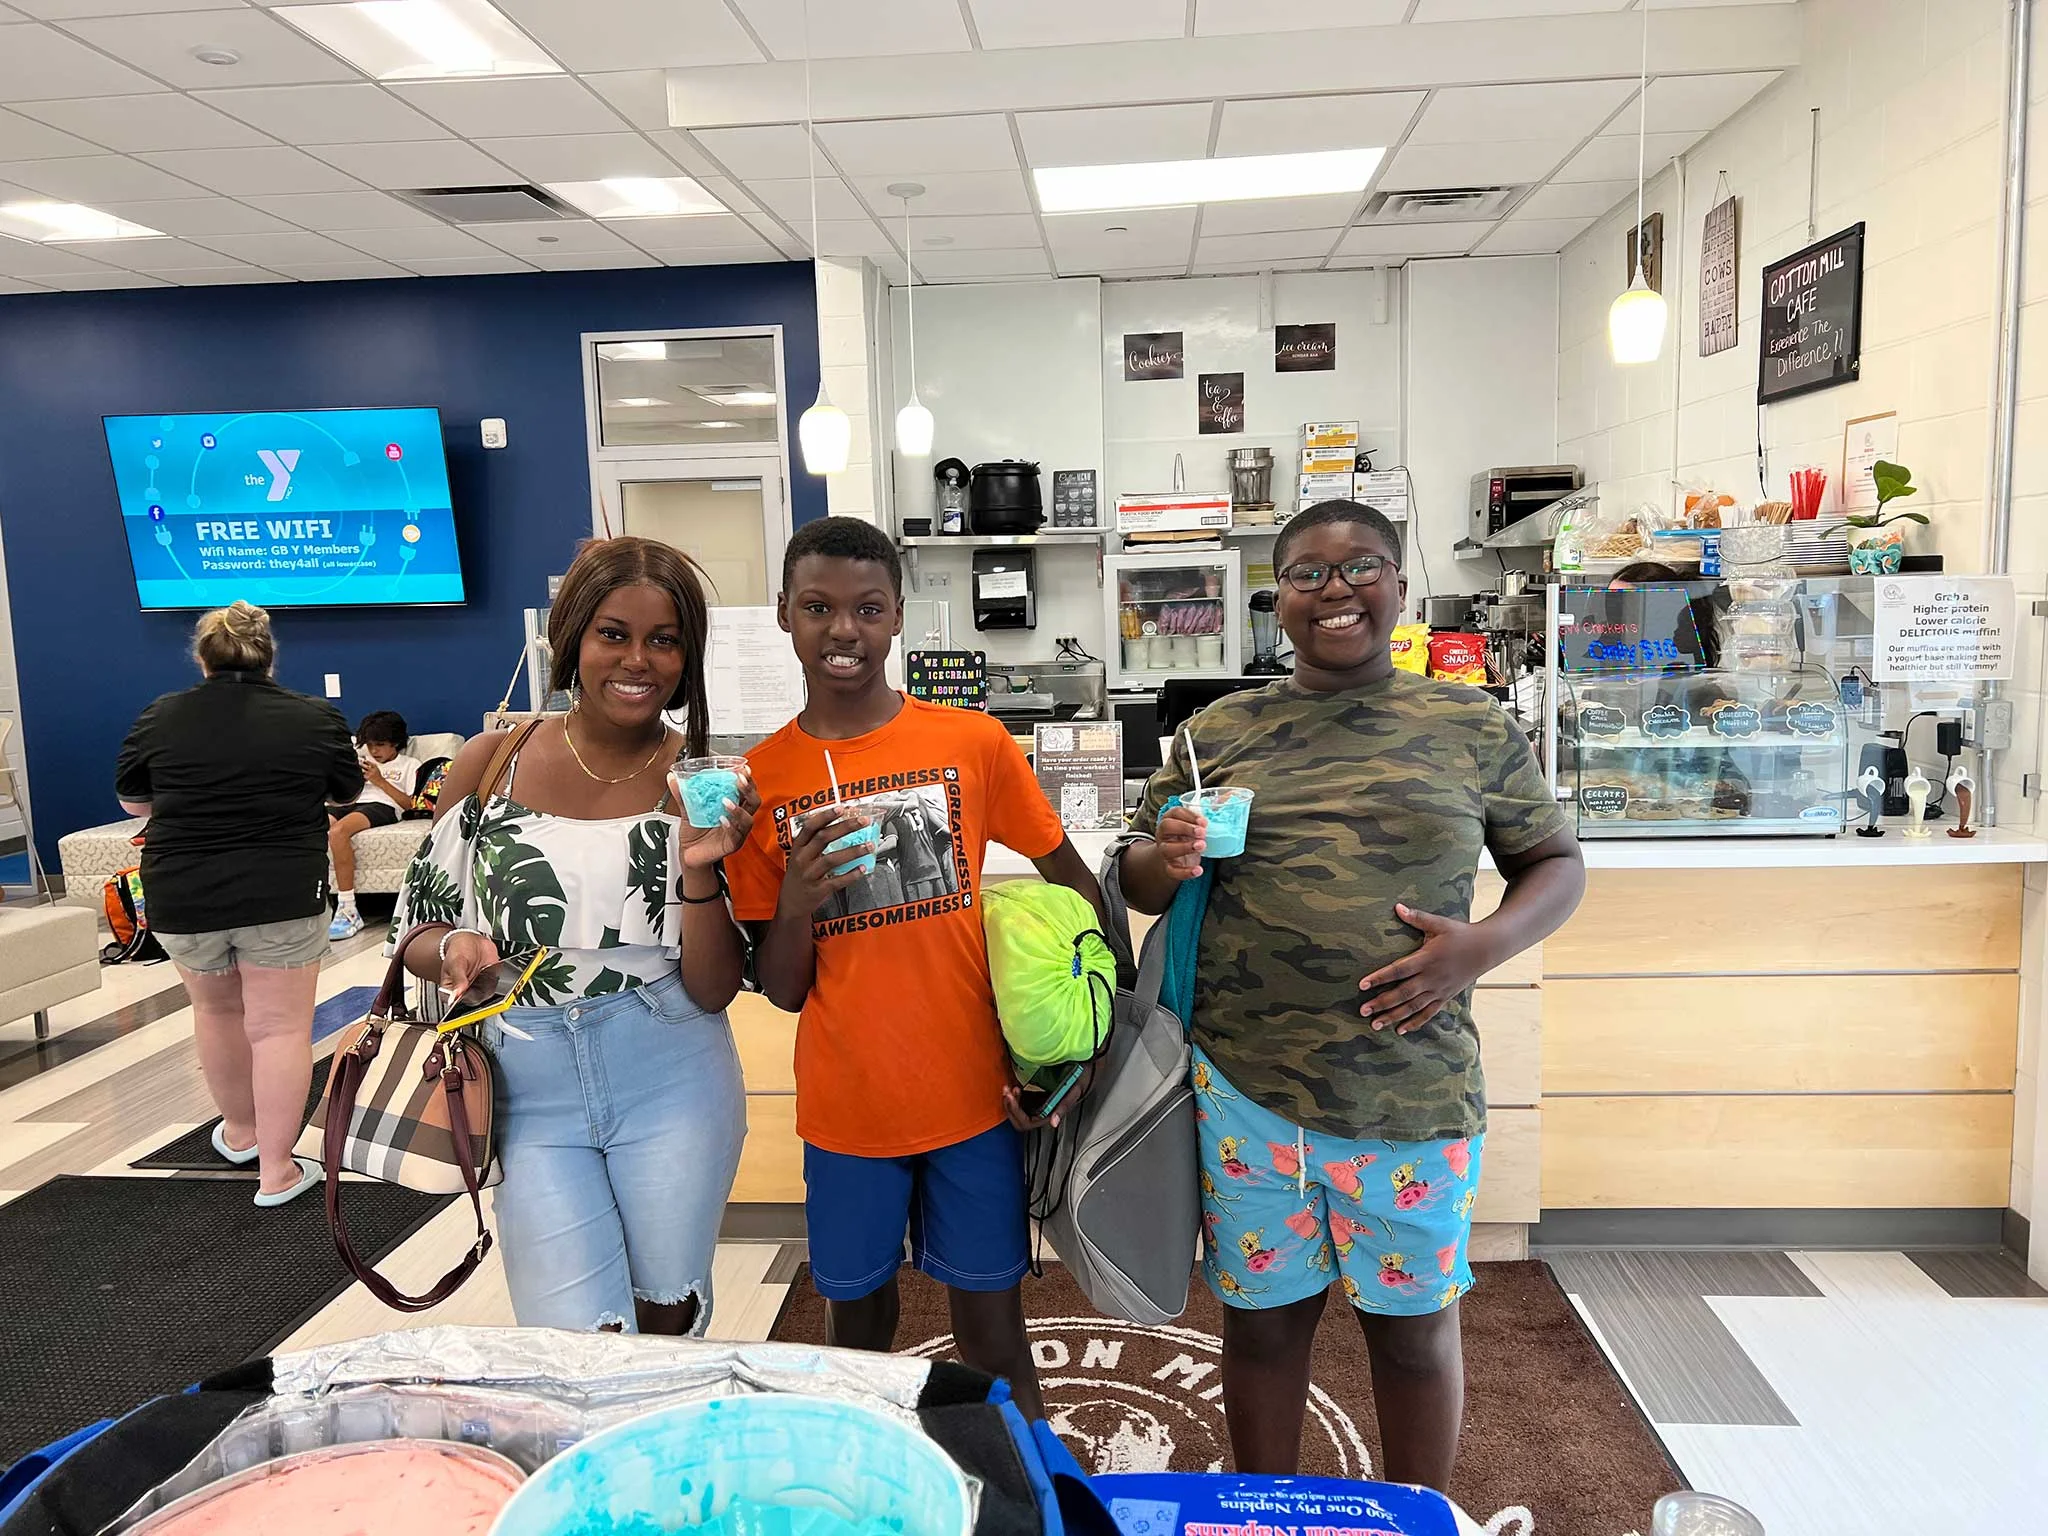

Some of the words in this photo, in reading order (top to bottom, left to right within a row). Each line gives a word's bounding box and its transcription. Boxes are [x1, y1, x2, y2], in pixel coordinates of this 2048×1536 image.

[1704, 260, 1732, 285] COWS
[1770, 261, 1817, 305] COTTON
[1819, 247, 1845, 277] MILL
[1787, 287, 1817, 323] CAFE
[1704, 313, 1732, 337] HAPPY
[1812, 319, 1832, 337] The
[1279, 341, 1294, 352] ice
[1297, 341, 1328, 353] cream
[1129, 344, 1175, 372] Cookies
[1203, 380, 1222, 398] tea
[1212, 388, 1230, 413] &
[1214, 406, 1240, 429] coffee
[244, 473, 265, 487] the
[196, 520, 260, 541] FREE
[266, 519, 333, 540] WIFI
[199, 546, 225, 557] Wifi
[227, 546, 268, 556] Name:
[270, 545, 289, 555] GB
[290, 545, 301, 555] Y
[303, 544, 360, 555] Members
[202, 560, 266, 570] Password:
[269, 558, 319, 571] they4all
[1935, 592, 1960, 601] Grab
[1913, 605, 1949, 615] Higher
[1951, 604, 1989, 615] protein
[1915, 617, 1948, 626] Lower
[1950, 616, 1986, 625] calorie
[1900, 628, 1960, 638] DELICIOUS
[1963, 627, 2001, 637] muffin!
[1390, 641, 1411, 653] ays
[1588, 640, 1636, 665] Only
[1639, 638, 1678, 662] $10
[1888, 644, 1905, 653] Our
[1906, 644, 1941, 652] muffins
[1956, 644, 1980, 652] made
[923, 658, 938, 668] WE
[942, 657, 966, 667] HAVE
[1894, 654, 1922, 664] yogurt
[1924, 653, 1945, 661] base
[1946, 652, 1978, 663] making
[1979, 652, 2001, 661] them
[1889, 663, 1927, 672] healthier
[1929, 662, 1944, 671] but
[1945, 662, 1962, 671] still
[1963, 662, 1998, 672] Yummy!
[911, 685, 927, 695] ASK
[932, 685, 960, 695] ABOUT
[962, 685, 979, 695] OUR
[789, 768, 940, 814] TOGETHERNESS
[1585, 790, 1625, 799] ECLAIRS
[948, 783, 972, 891] GREATNESS
[819, 895, 960, 937] AWESOMENESS
[1221, 1499, 1292, 1514] Napkins
[1296, 1500, 1322, 1515] Ply
[1326, 1504, 1363, 1517] One
